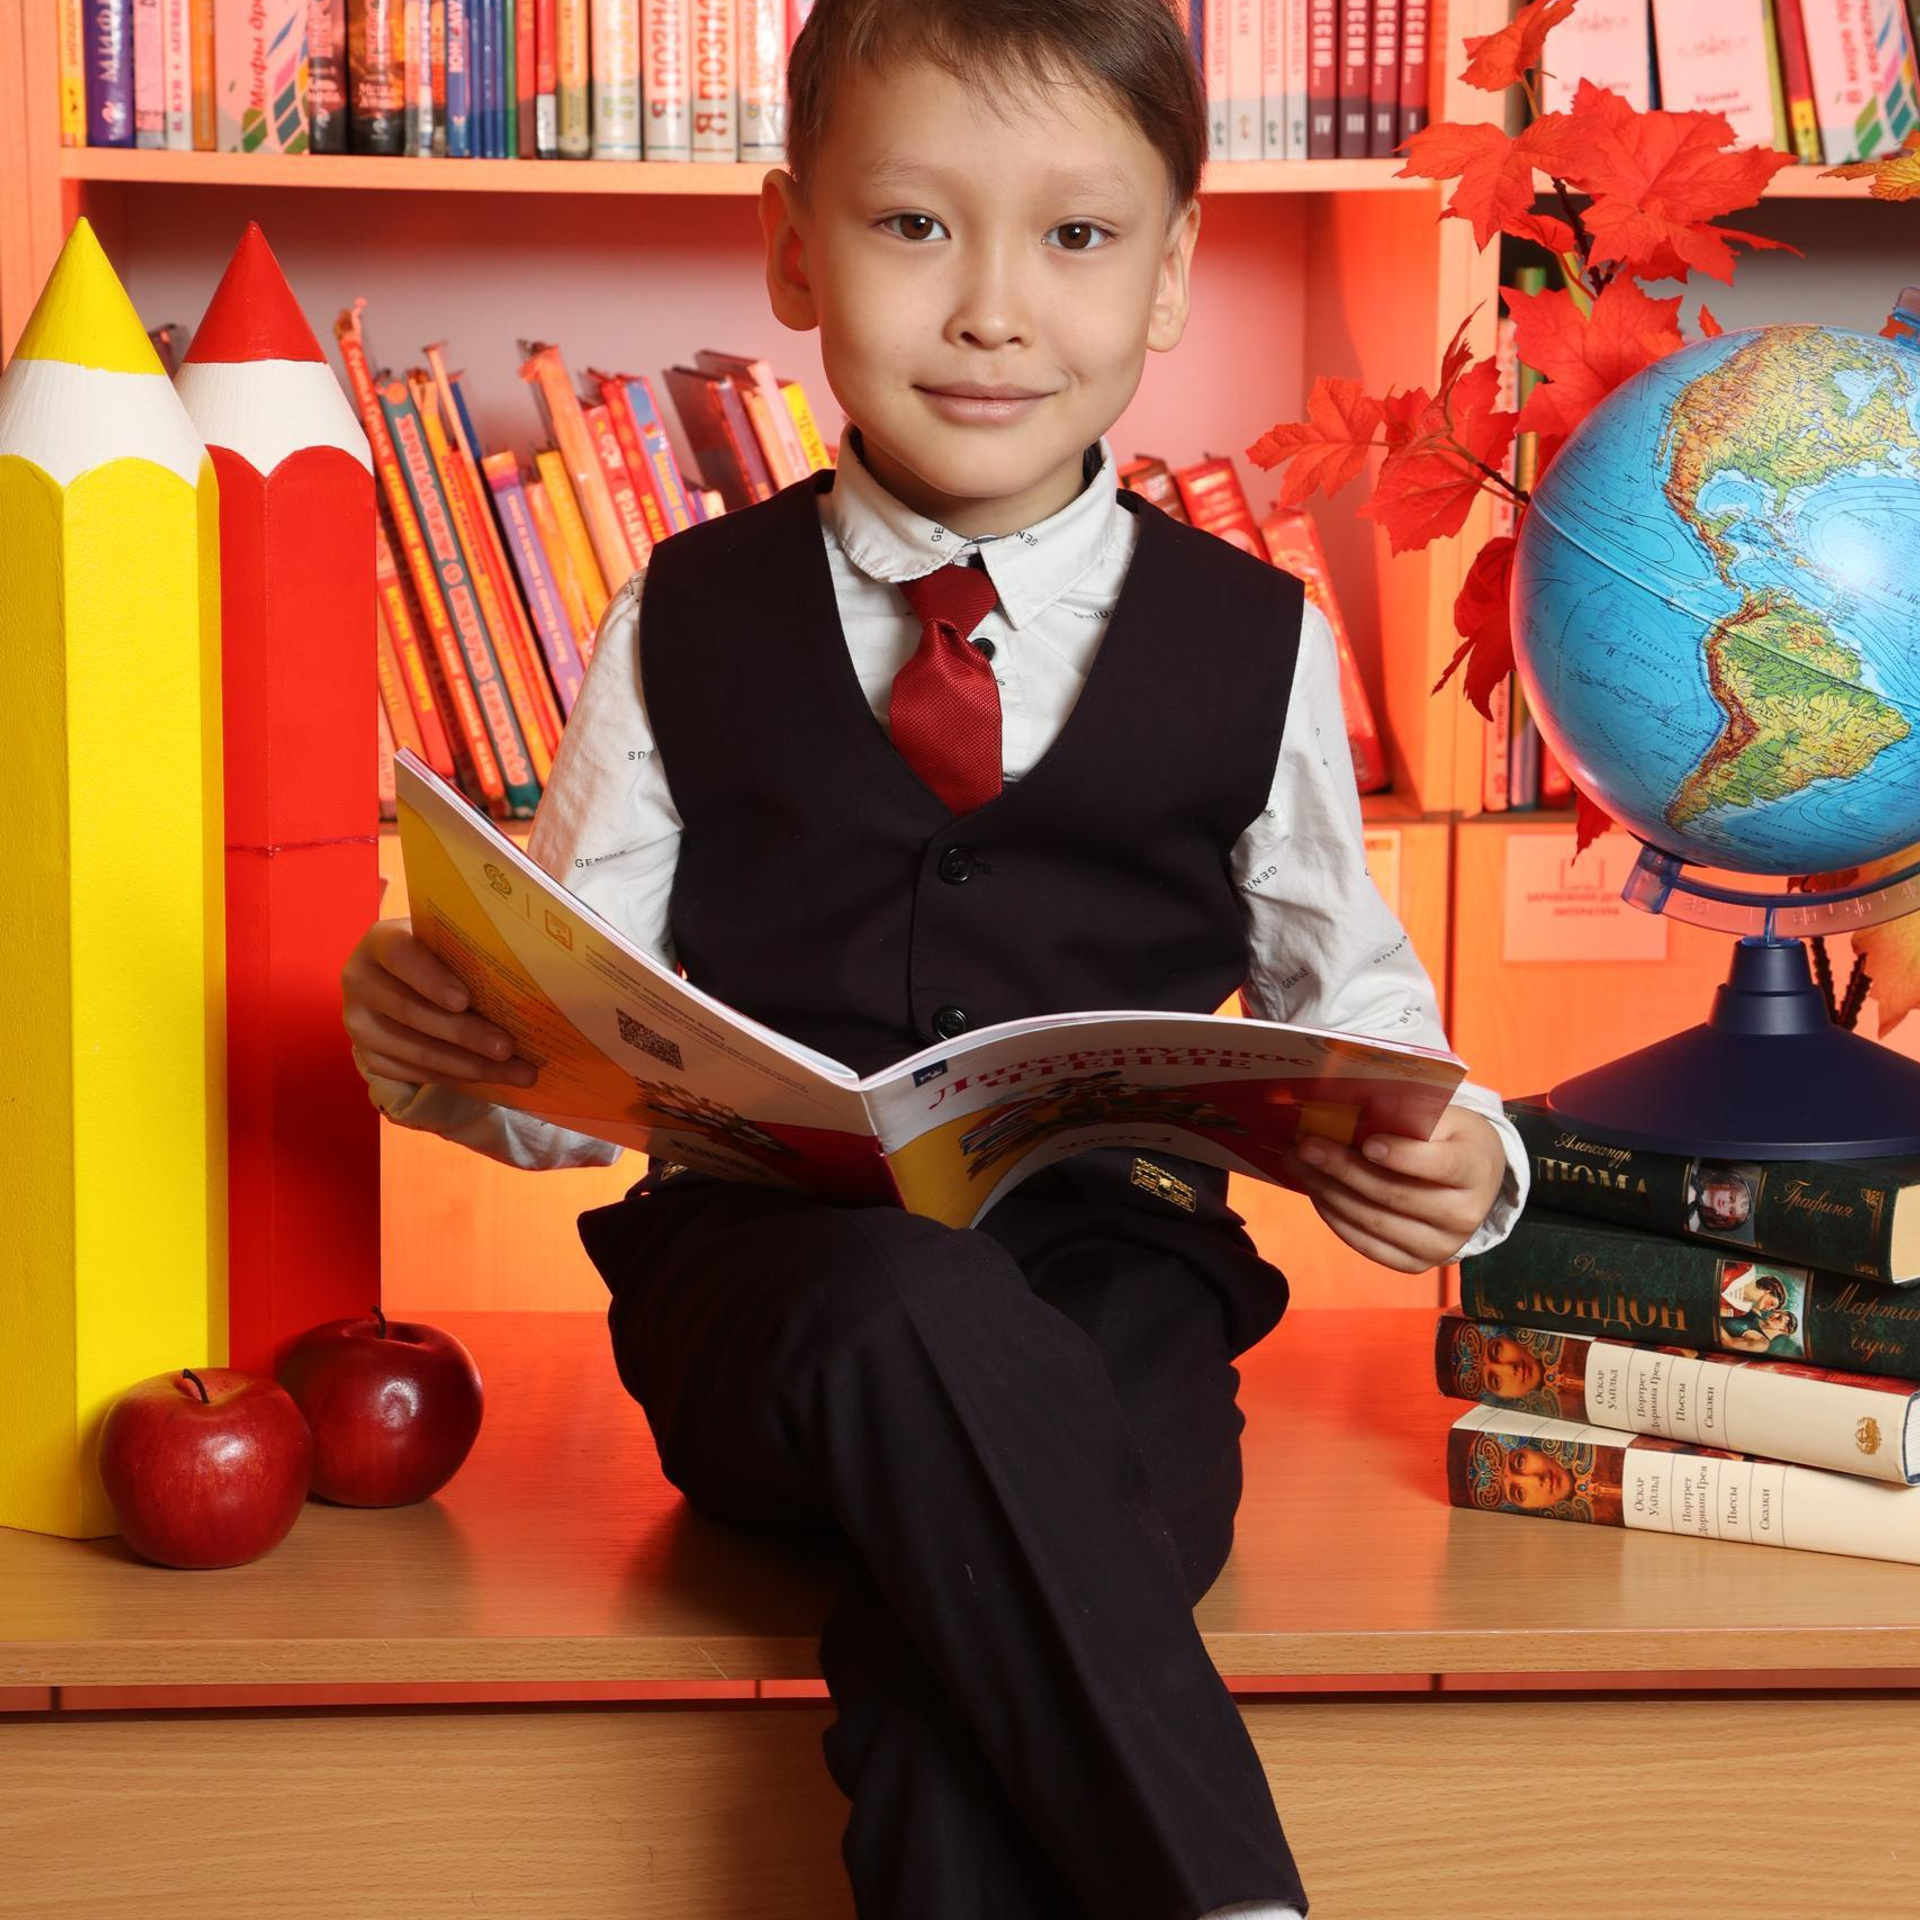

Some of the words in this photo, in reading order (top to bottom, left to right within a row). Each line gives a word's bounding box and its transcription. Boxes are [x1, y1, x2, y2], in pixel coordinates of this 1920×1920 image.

[246, 0, 268, 31] др
[95, 0, 122, 83] МИФ
[249, 36, 268, 109] Мифы
[694, 113, 728, 134] Я
[1313, 114, 1333, 136] IV
[1346, 113, 1366, 134] III
[1376, 112, 1391, 133] II
[393, 411, 458, 564] ЖИВОТНЫХ
[440, 560, 466, 587] О
[447, 582, 495, 683] СКАЗКИ
[478, 677, 531, 788] РУССКИЕ
[929, 1047, 1315, 1110] Литературное
[1554, 1132, 1634, 1170] Александр
[1774, 1180, 1855, 1218] Графиня
[1516, 1284, 1689, 1332] ЛОНДОН
[1637, 1372, 1647, 1418] Портрет
[1650, 1361, 1661, 1386] Грея
[1650, 1388, 1662, 1432] Дориана
[1676, 1382, 1687, 1422] Пьесы
[1704, 1386, 1715, 1429] Сказки
[1697, 1465, 1709, 1490] Грея
[1682, 1477, 1694, 1523] Портрет
[1697, 1491, 1710, 1536] Дориана
[1727, 1486, 1738, 1525] Пьесы
[1759, 1488, 1771, 1531] Сказки
